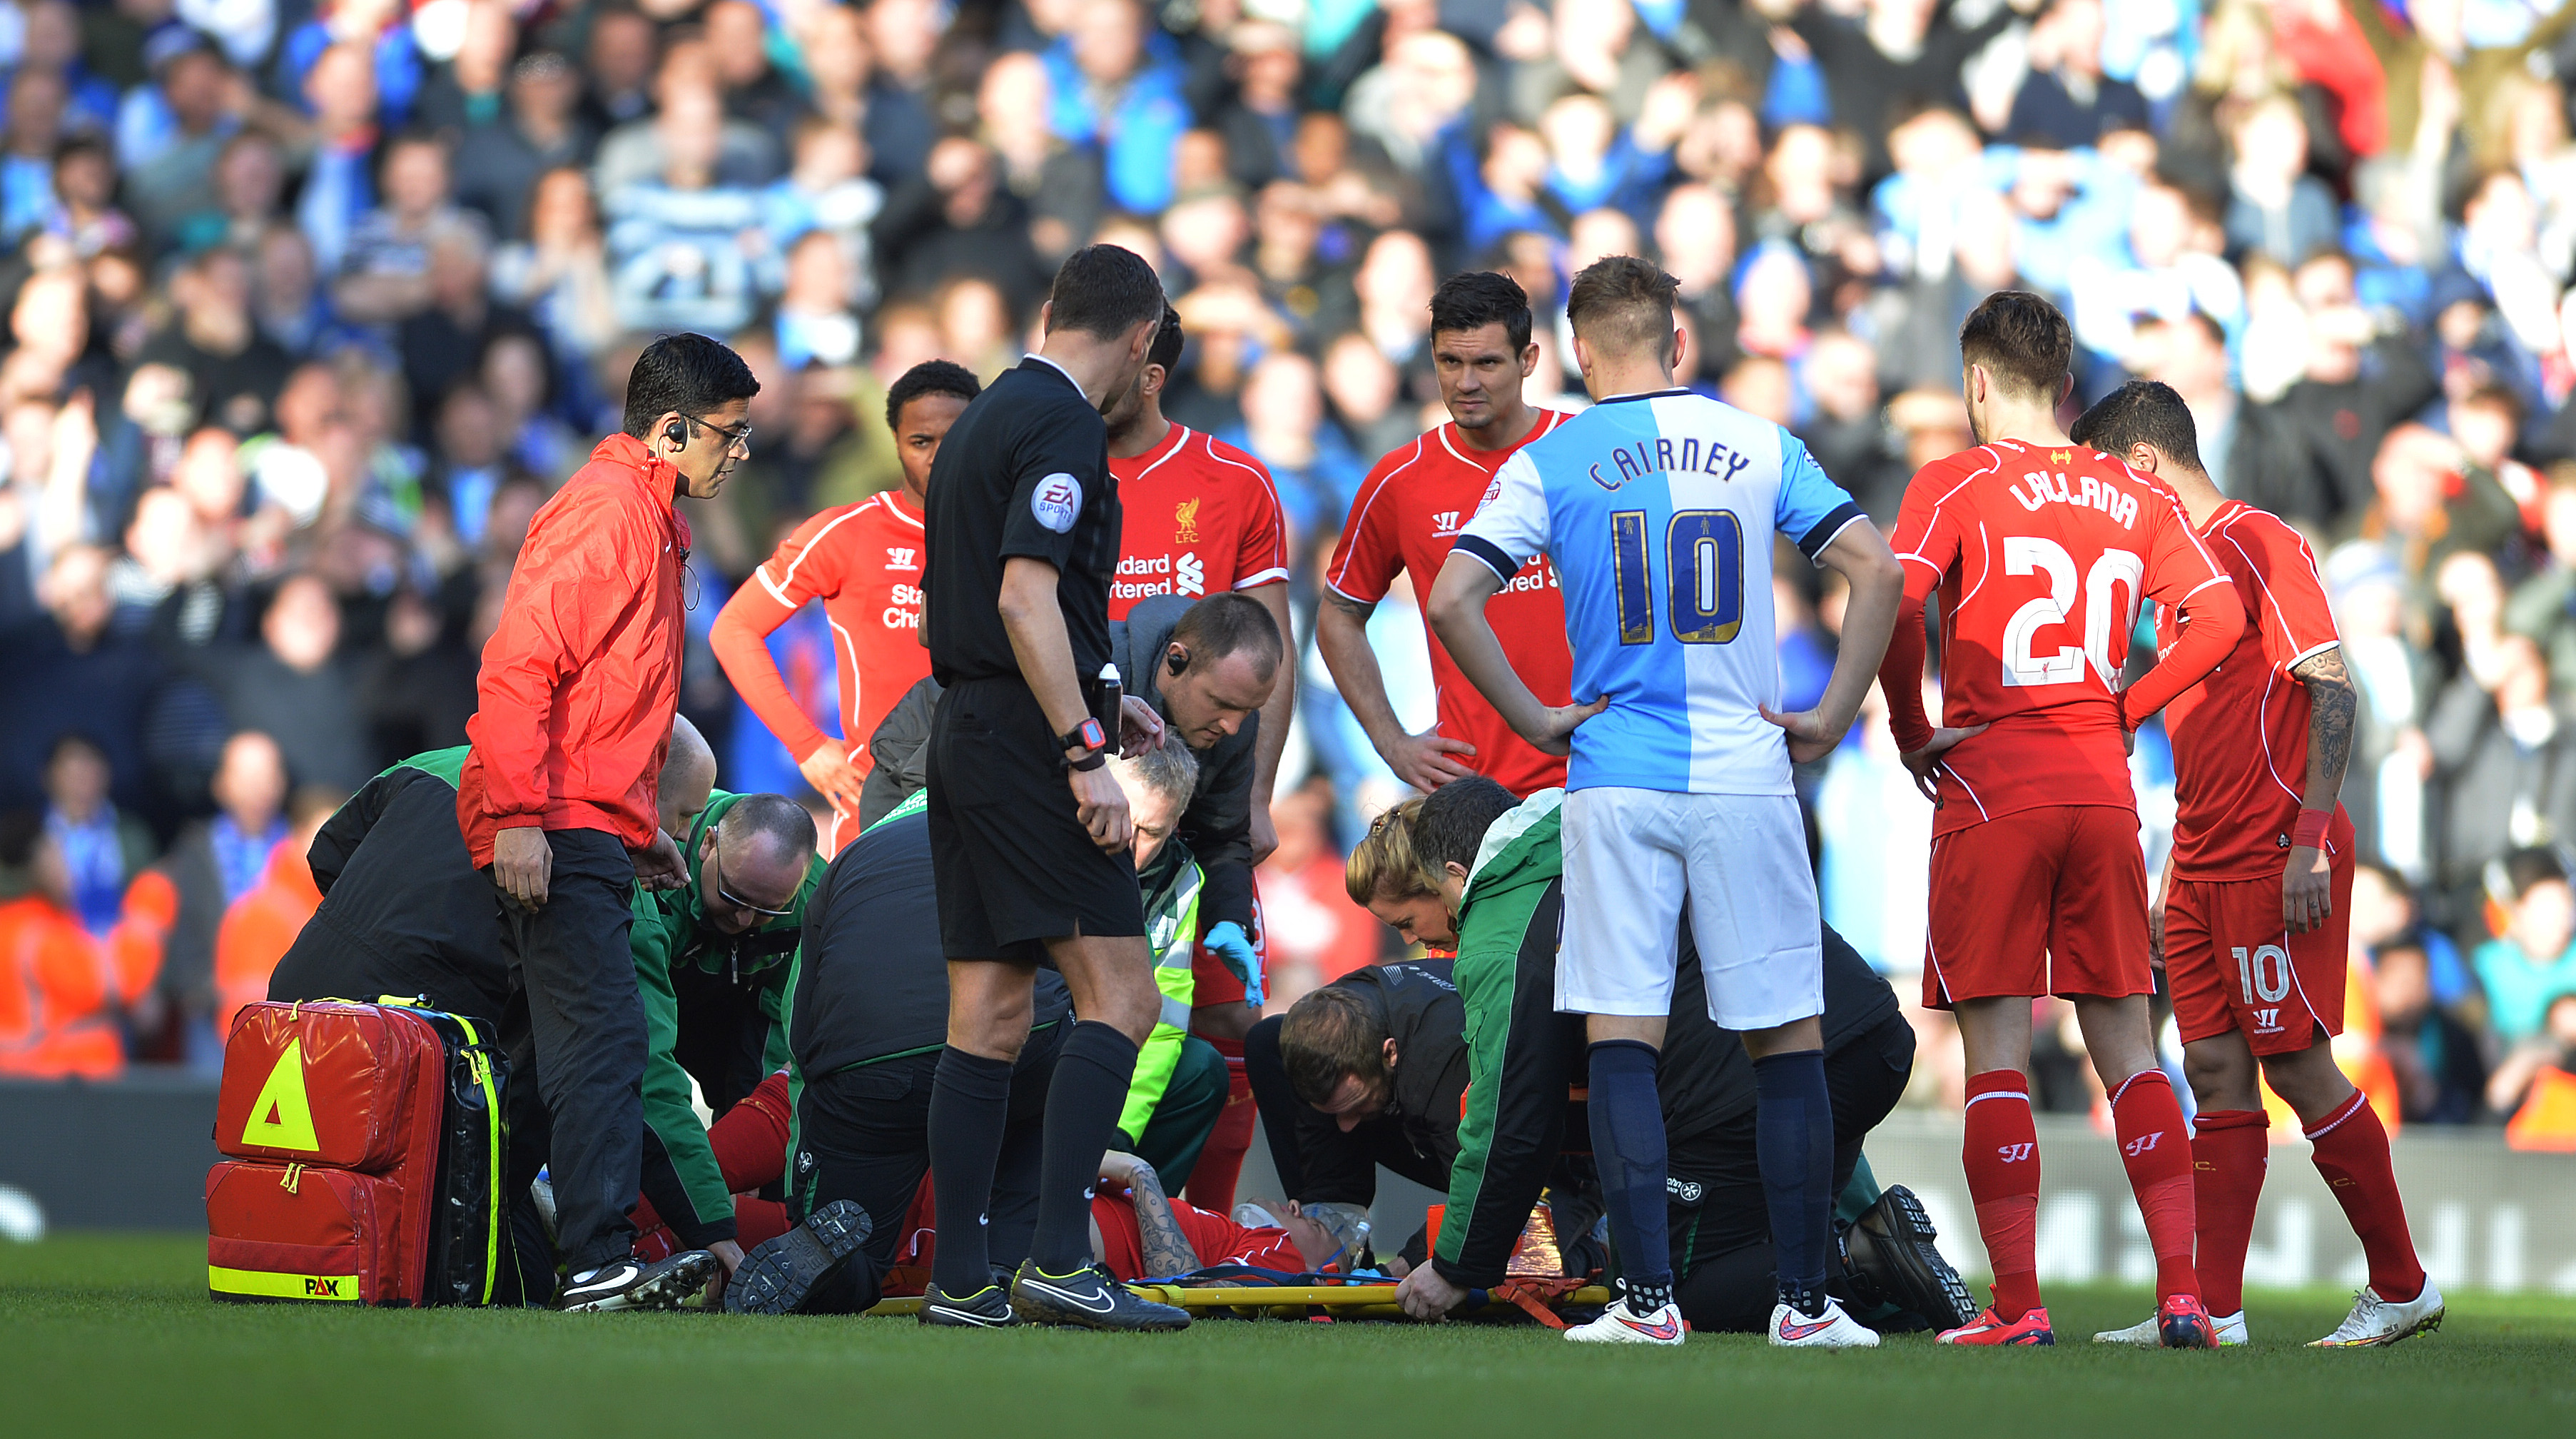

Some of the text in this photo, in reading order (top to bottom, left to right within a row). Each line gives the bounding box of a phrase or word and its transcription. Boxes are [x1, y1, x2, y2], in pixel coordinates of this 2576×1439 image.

[1588, 437, 1751, 492] CAIRNEY
[1043, 484, 1074, 513] EA
[2009, 470, 2139, 530] LALLANA
[1610, 509, 1745, 646] 10
[2002, 537, 2144, 695] 20
[2231, 944, 2290, 1004] 10
[305, 1275, 339, 1296] PAX
